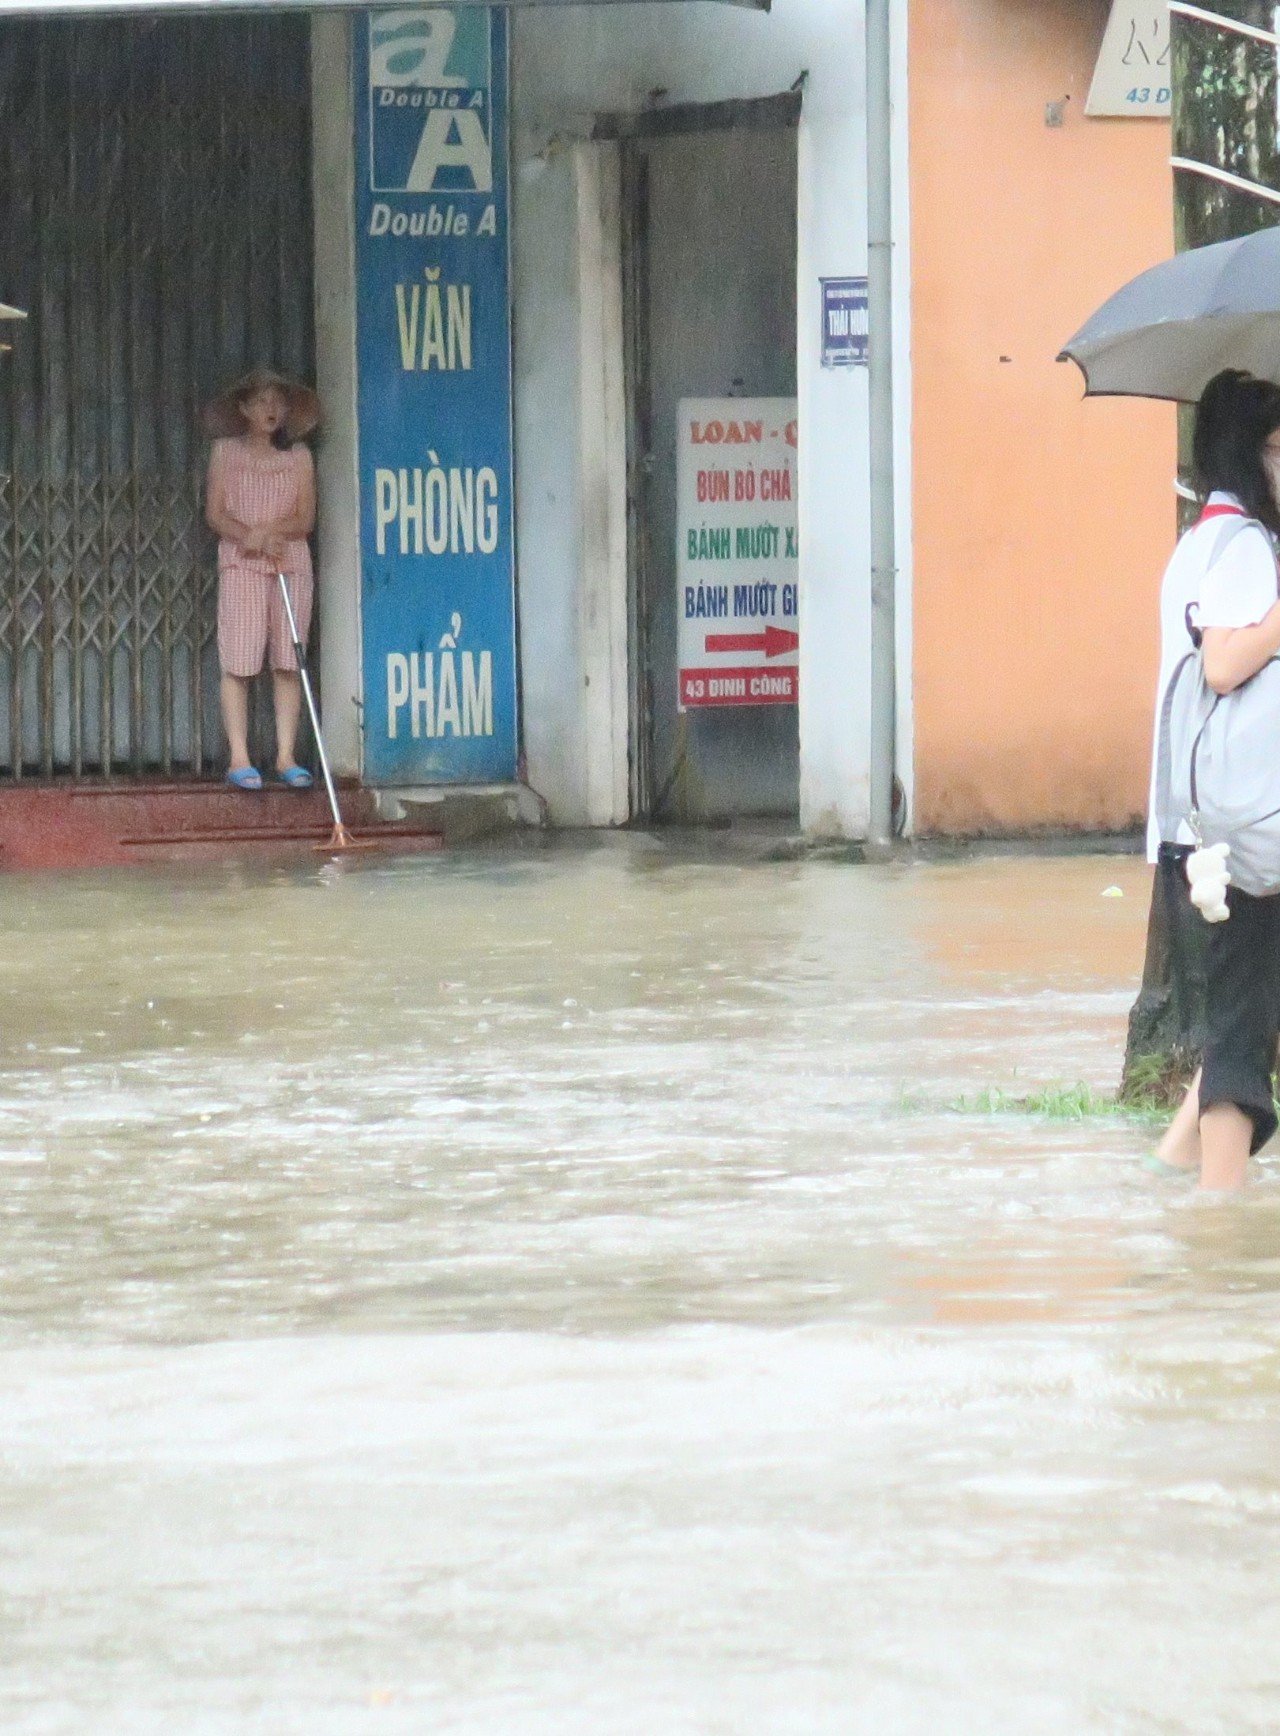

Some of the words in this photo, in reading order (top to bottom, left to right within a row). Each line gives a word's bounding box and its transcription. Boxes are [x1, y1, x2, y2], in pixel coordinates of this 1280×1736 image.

[380, 89, 460, 107] Double
[468, 89, 484, 108] A
[1126, 87, 1151, 103] 43
[406, 109, 492, 193] A
[369, 203, 469, 236] Double
[476, 204, 497, 236] A
[395, 265, 472, 371] VĂN
[690, 419, 764, 444] LOAN
[375, 450, 499, 555] PHÒNG
[688, 521, 731, 560] BÁNH
[685, 578, 728, 618] BÁNH
[783, 584, 798, 616] GI
[387, 611, 493, 739] PHẨM
[686, 679, 705, 698] 43
[750, 674, 793, 696] CÔNG
